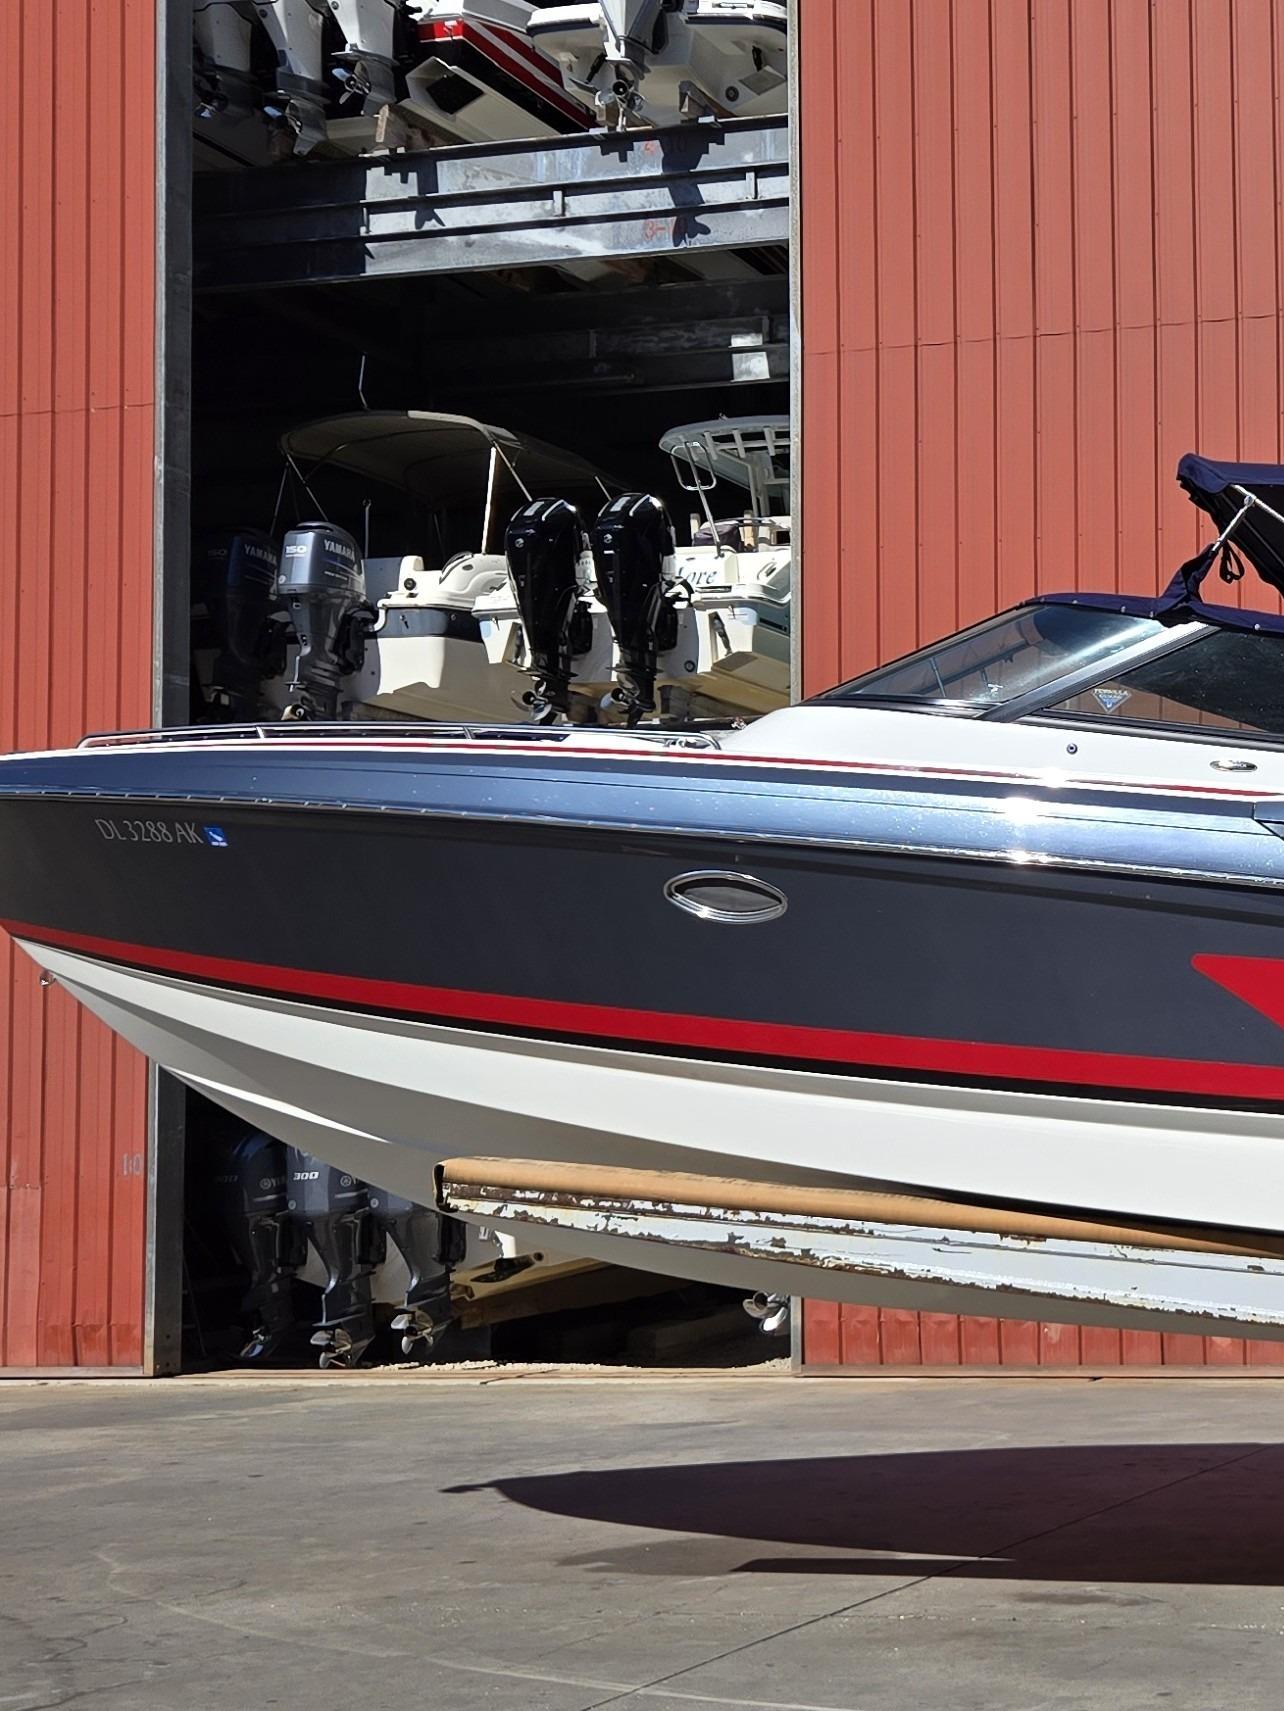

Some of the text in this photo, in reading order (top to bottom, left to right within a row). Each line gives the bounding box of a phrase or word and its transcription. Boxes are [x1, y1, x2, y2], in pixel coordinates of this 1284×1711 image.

[285, 545, 308, 554] 150
[94, 818, 204, 845] DL 3288 AK
[292, 1171, 320, 1181] 300
